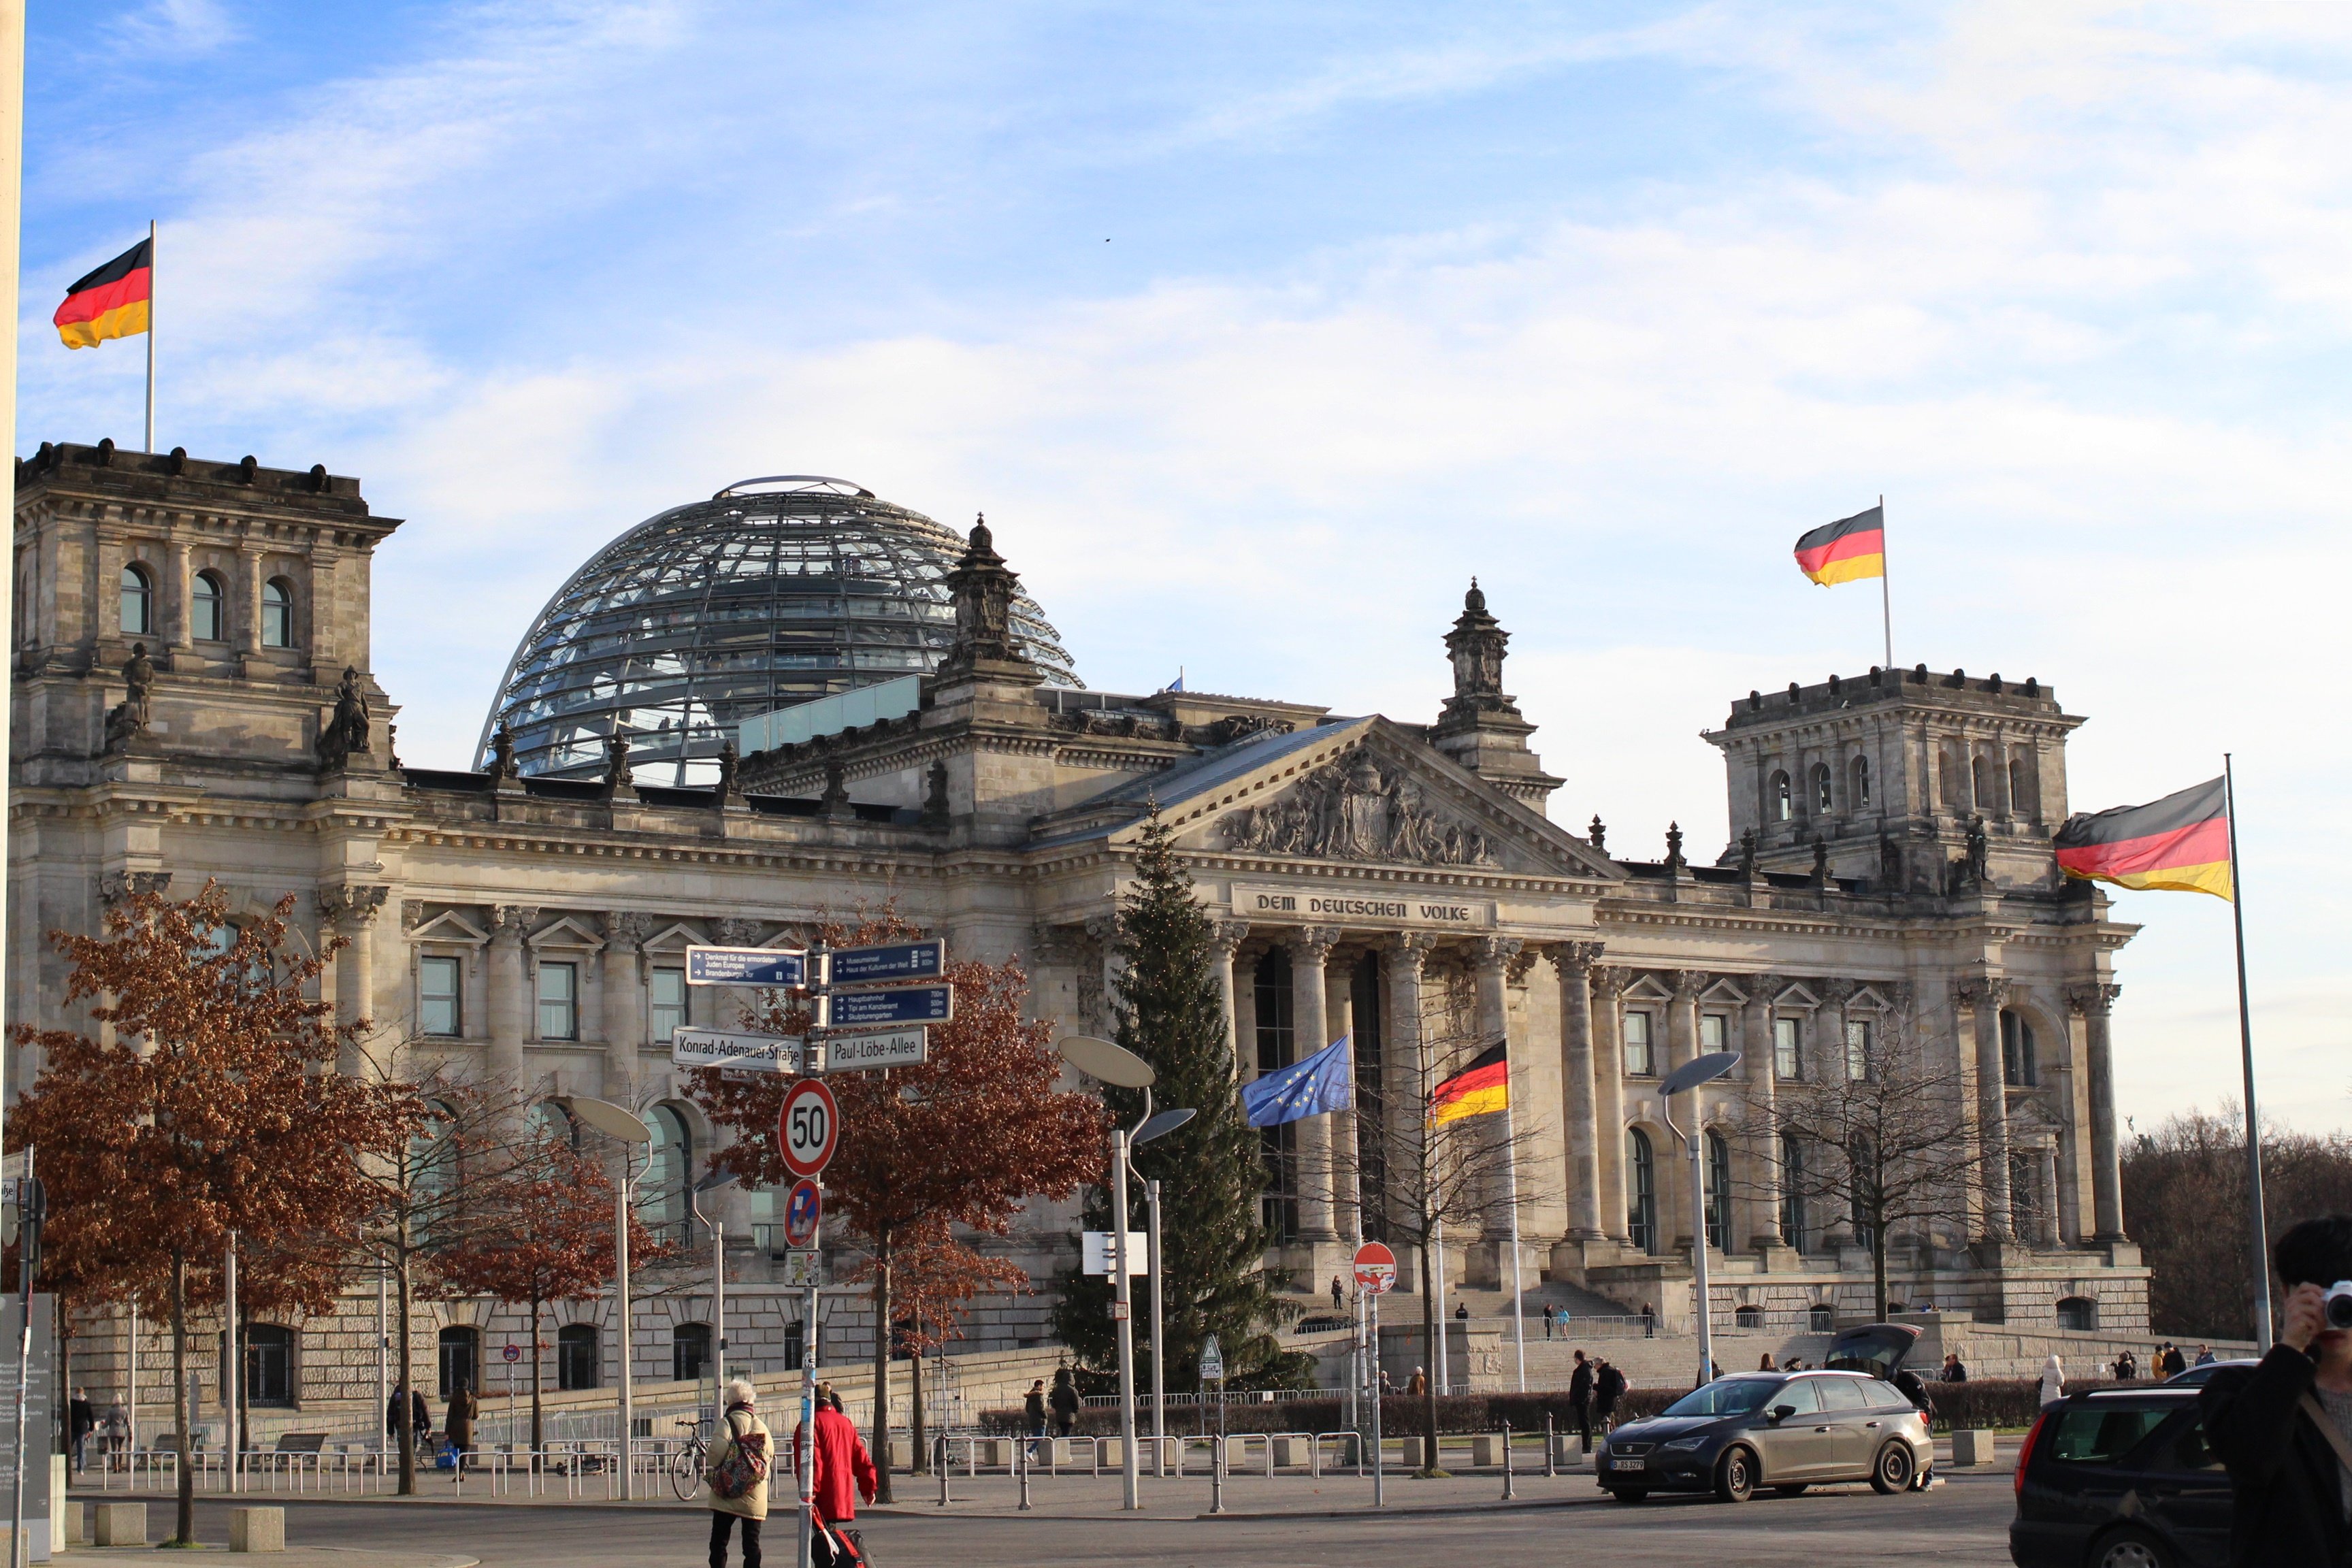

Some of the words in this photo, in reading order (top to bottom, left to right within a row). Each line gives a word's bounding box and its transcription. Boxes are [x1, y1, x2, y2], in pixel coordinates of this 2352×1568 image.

[1257, 894, 1296, 911] DEM
[1310, 898, 1407, 917] DEUTSCHEN
[1420, 904, 1469, 921] VOLKE
[846, 956, 880, 964] Museumsinsel
[723, 962, 745, 970] Europas
[705, 970, 745, 979] Brandenburger
[848, 994, 885, 1002] Hauptbahnhof
[868, 1002, 898, 1011] Kanzleramt
[848, 1012, 892, 1021] Skulpturengarten
[679, 1036, 799, 1064] Konrad-Adenauer-Straße
[834, 1036, 915, 1060] Paul-Löbe-Allee
[792, 1105, 824, 1149] 50
